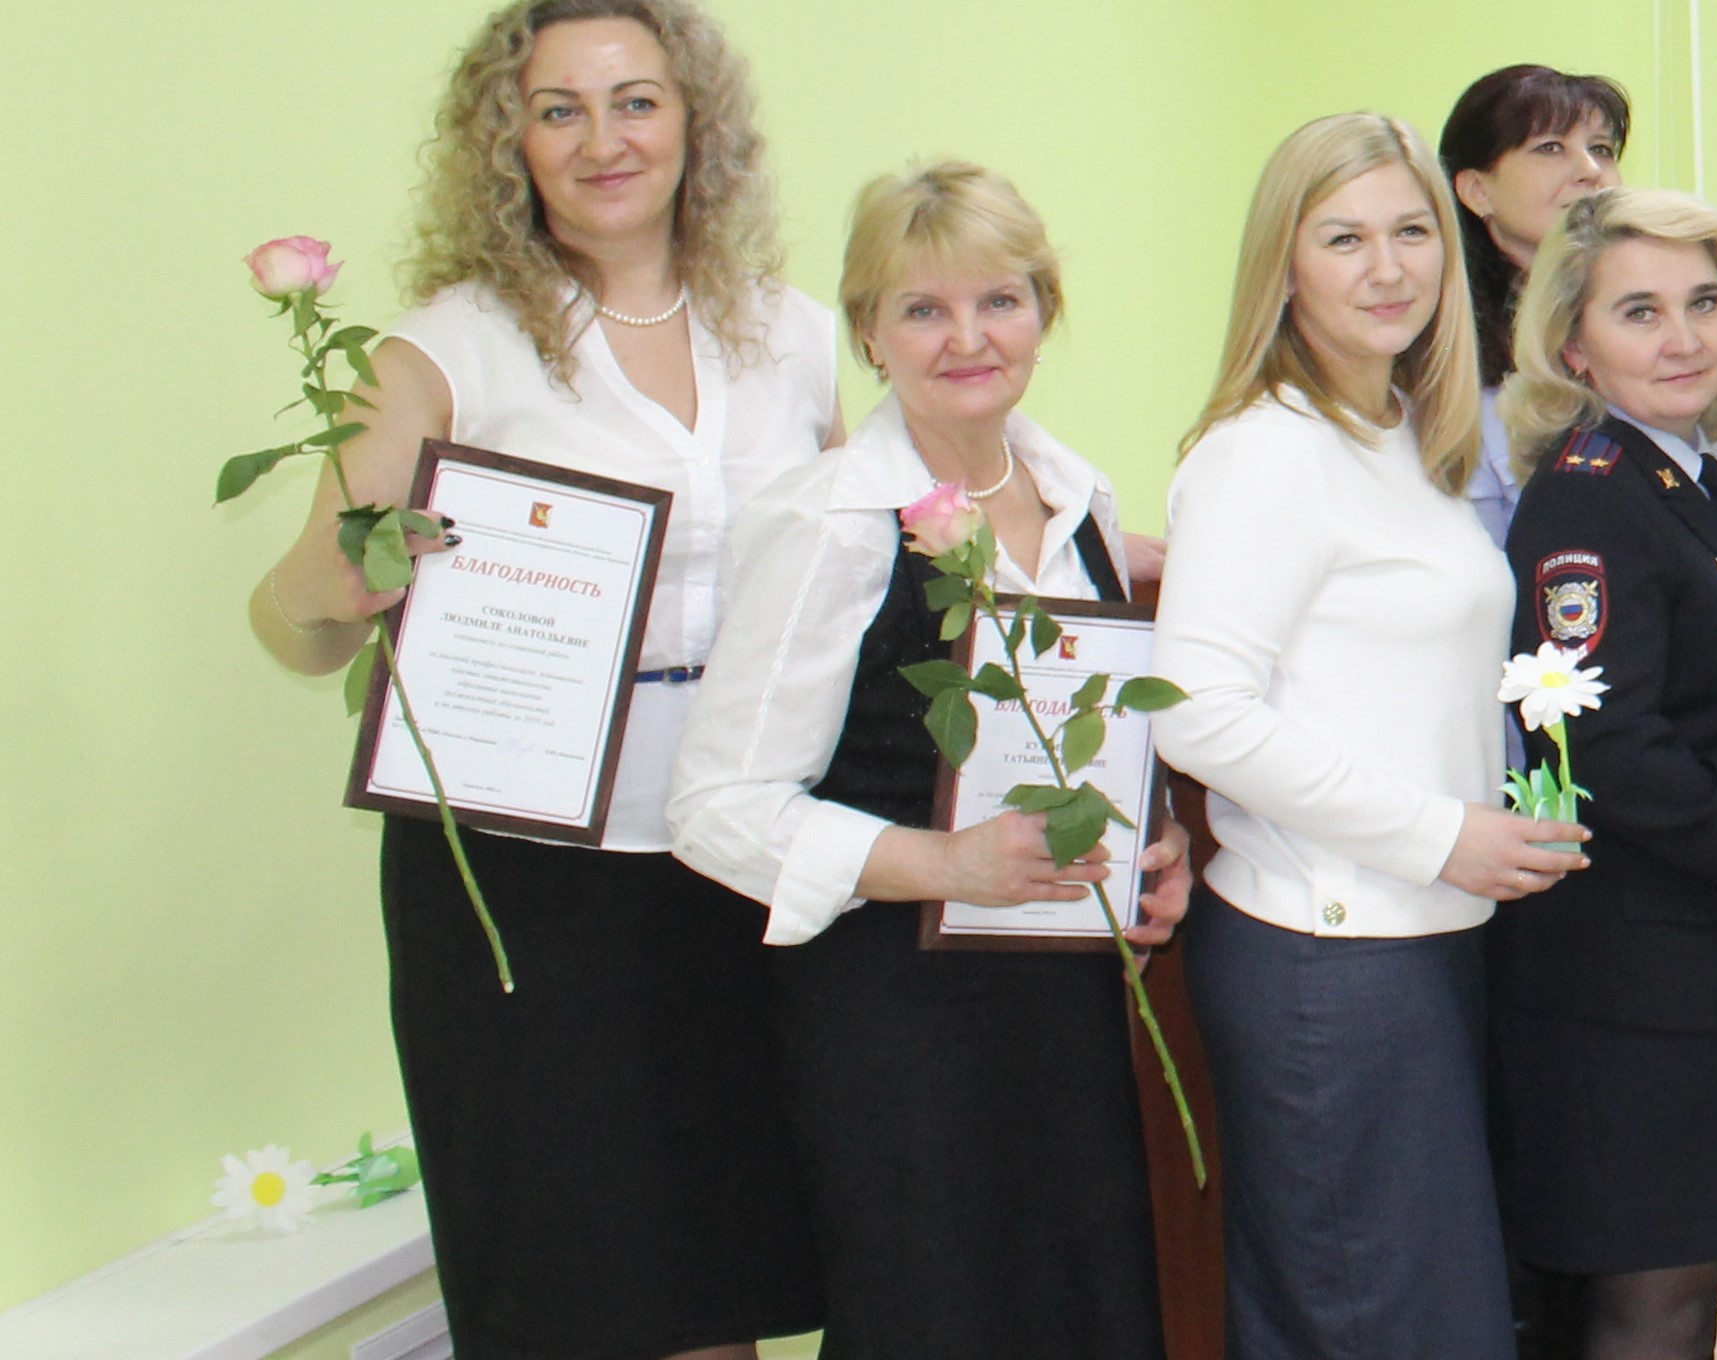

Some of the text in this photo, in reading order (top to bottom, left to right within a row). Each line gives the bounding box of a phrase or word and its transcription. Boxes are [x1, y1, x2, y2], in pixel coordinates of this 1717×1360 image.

[450, 554, 602, 599] БЛАГОДАРНОСТЬ
[1542, 553, 1599, 574] ПОЛИЦИЯ
[440, 612, 503, 633] ЛЮДМИЛЕ
[506, 624, 590, 649] АНАТОЛЬЕВНЕ
[481, 605, 556, 628] СОКОЛОВОЙ
